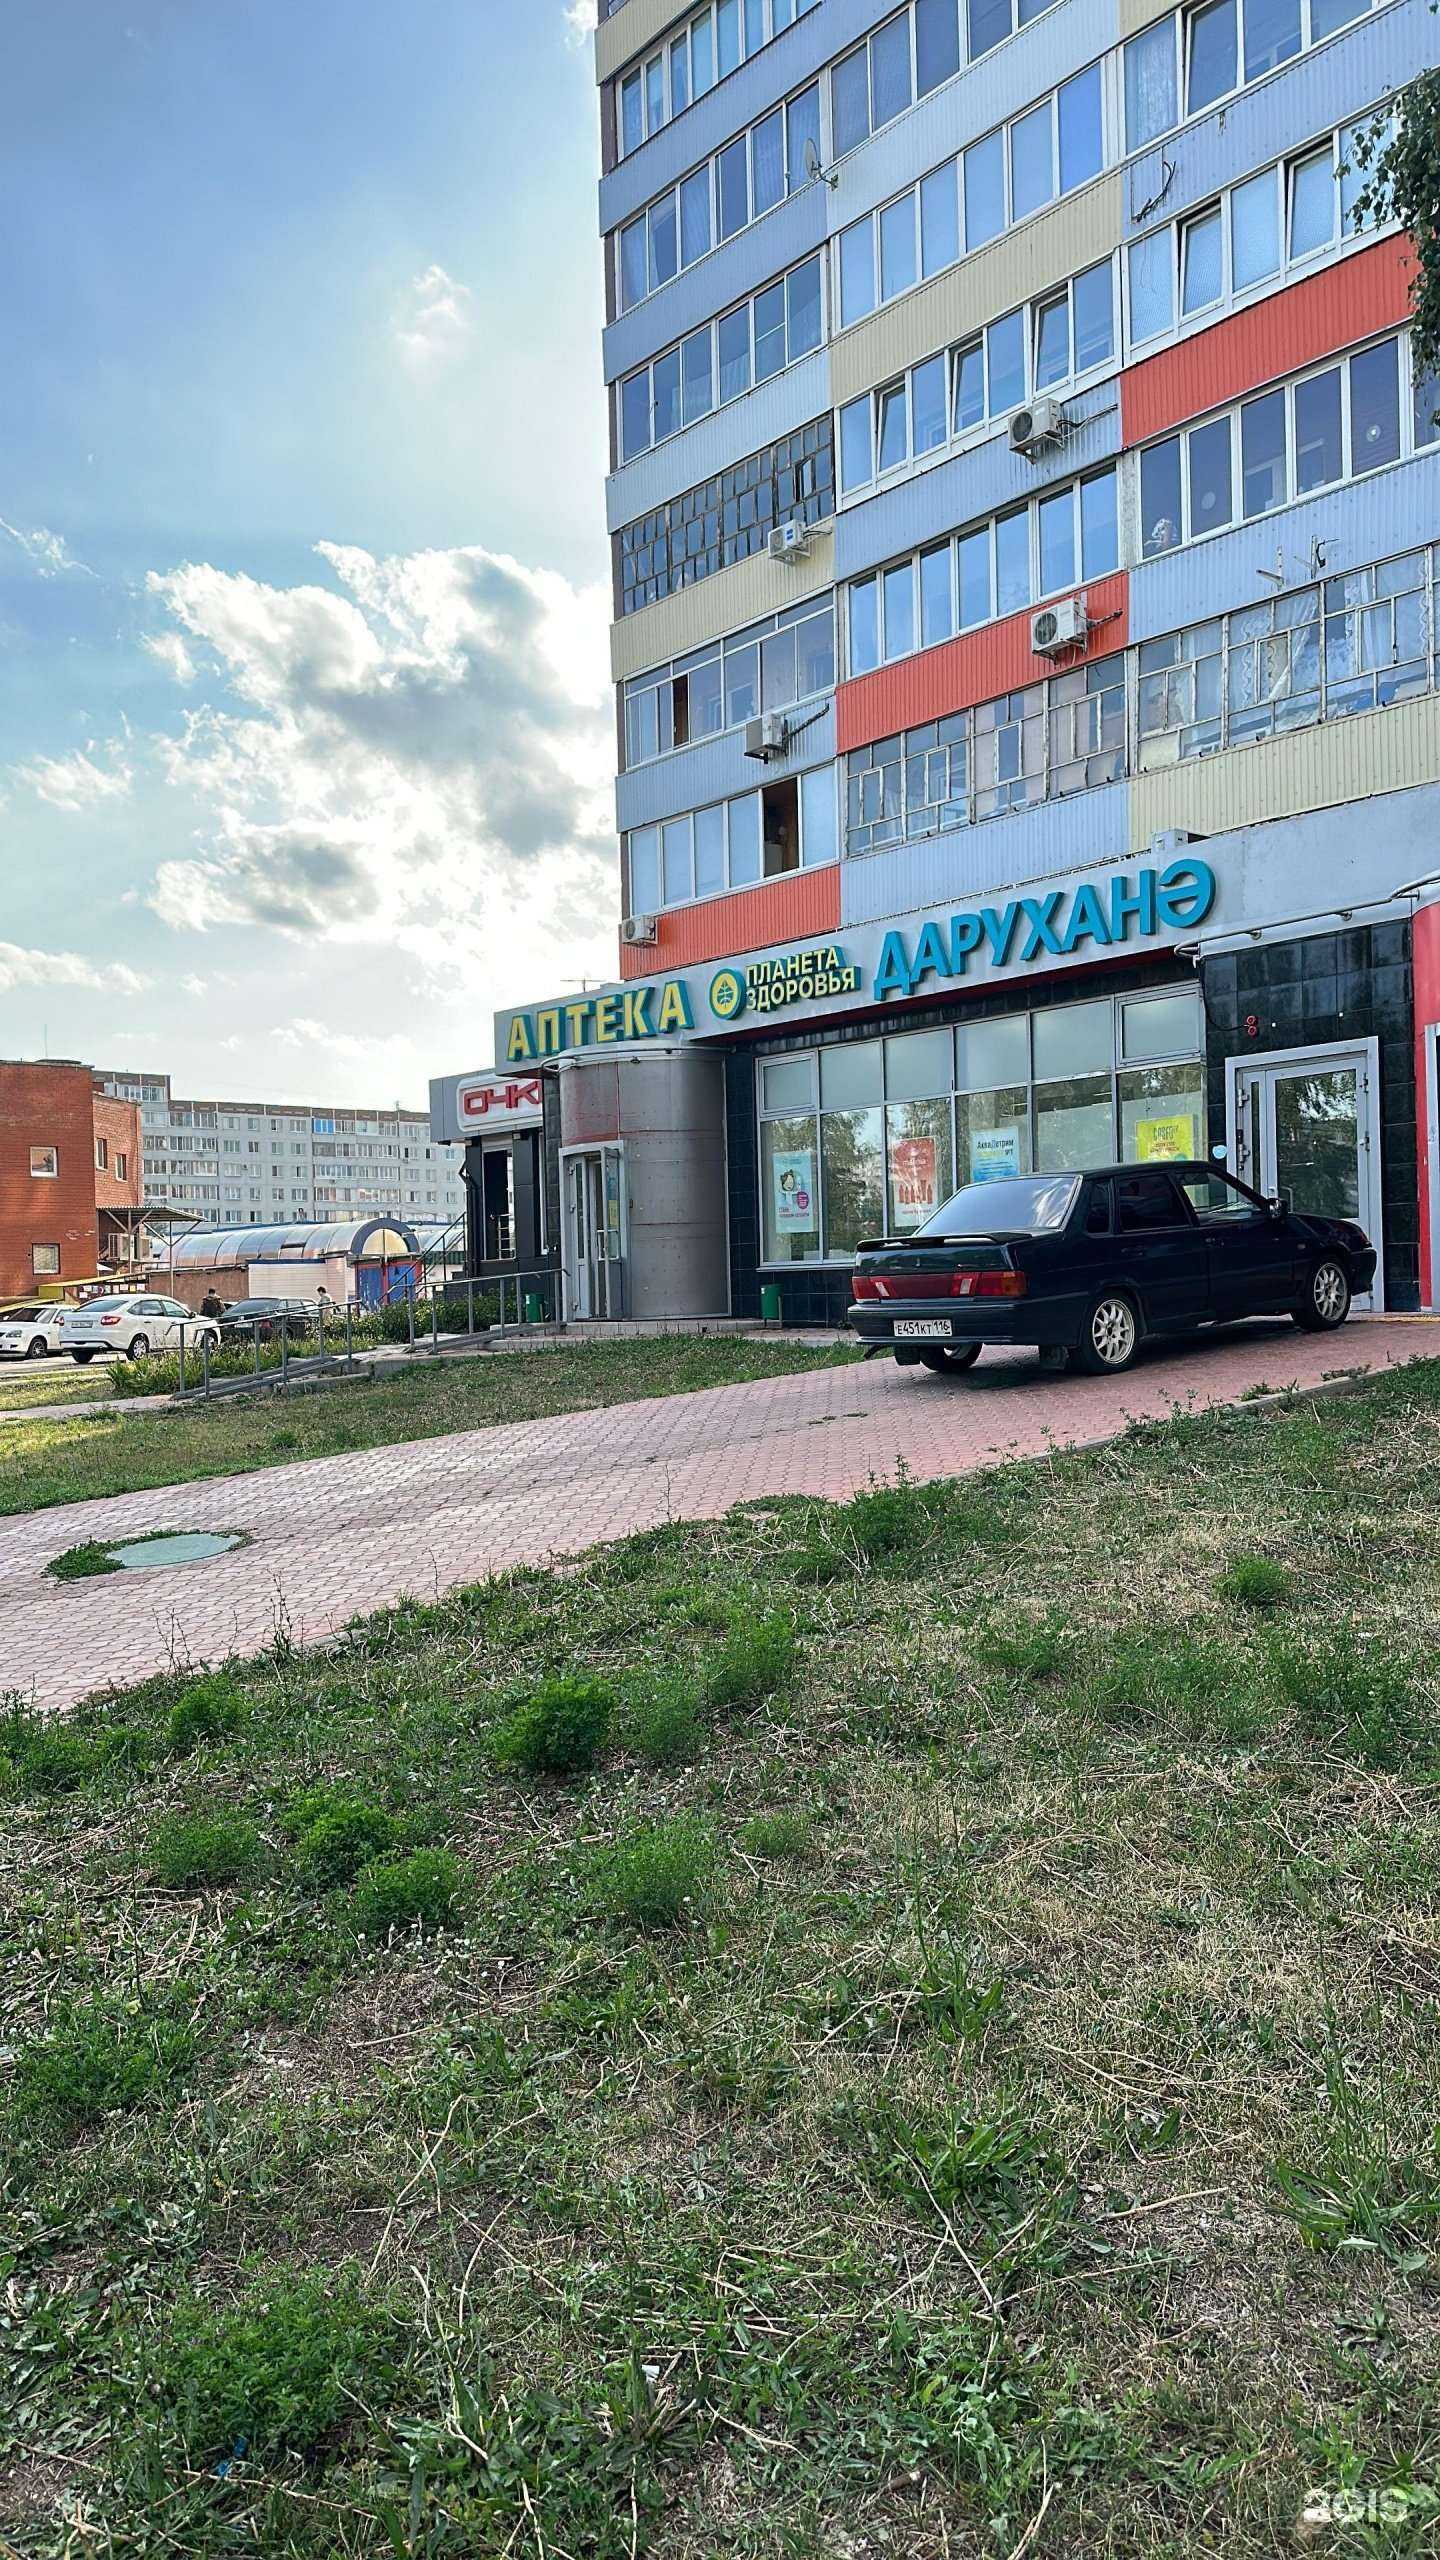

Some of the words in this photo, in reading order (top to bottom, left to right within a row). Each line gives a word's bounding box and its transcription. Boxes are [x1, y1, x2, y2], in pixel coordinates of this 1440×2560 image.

[873, 858, 1216, 1001] ДАРУХАНӘ
[746, 946, 845, 987] ПЛАНЕТА
[746, 966, 861, 1012] ЗДОРОВЬЯ
[506, 979, 695, 1062] АПТЕКА
[463, 1080, 542, 1116] ОЧК
